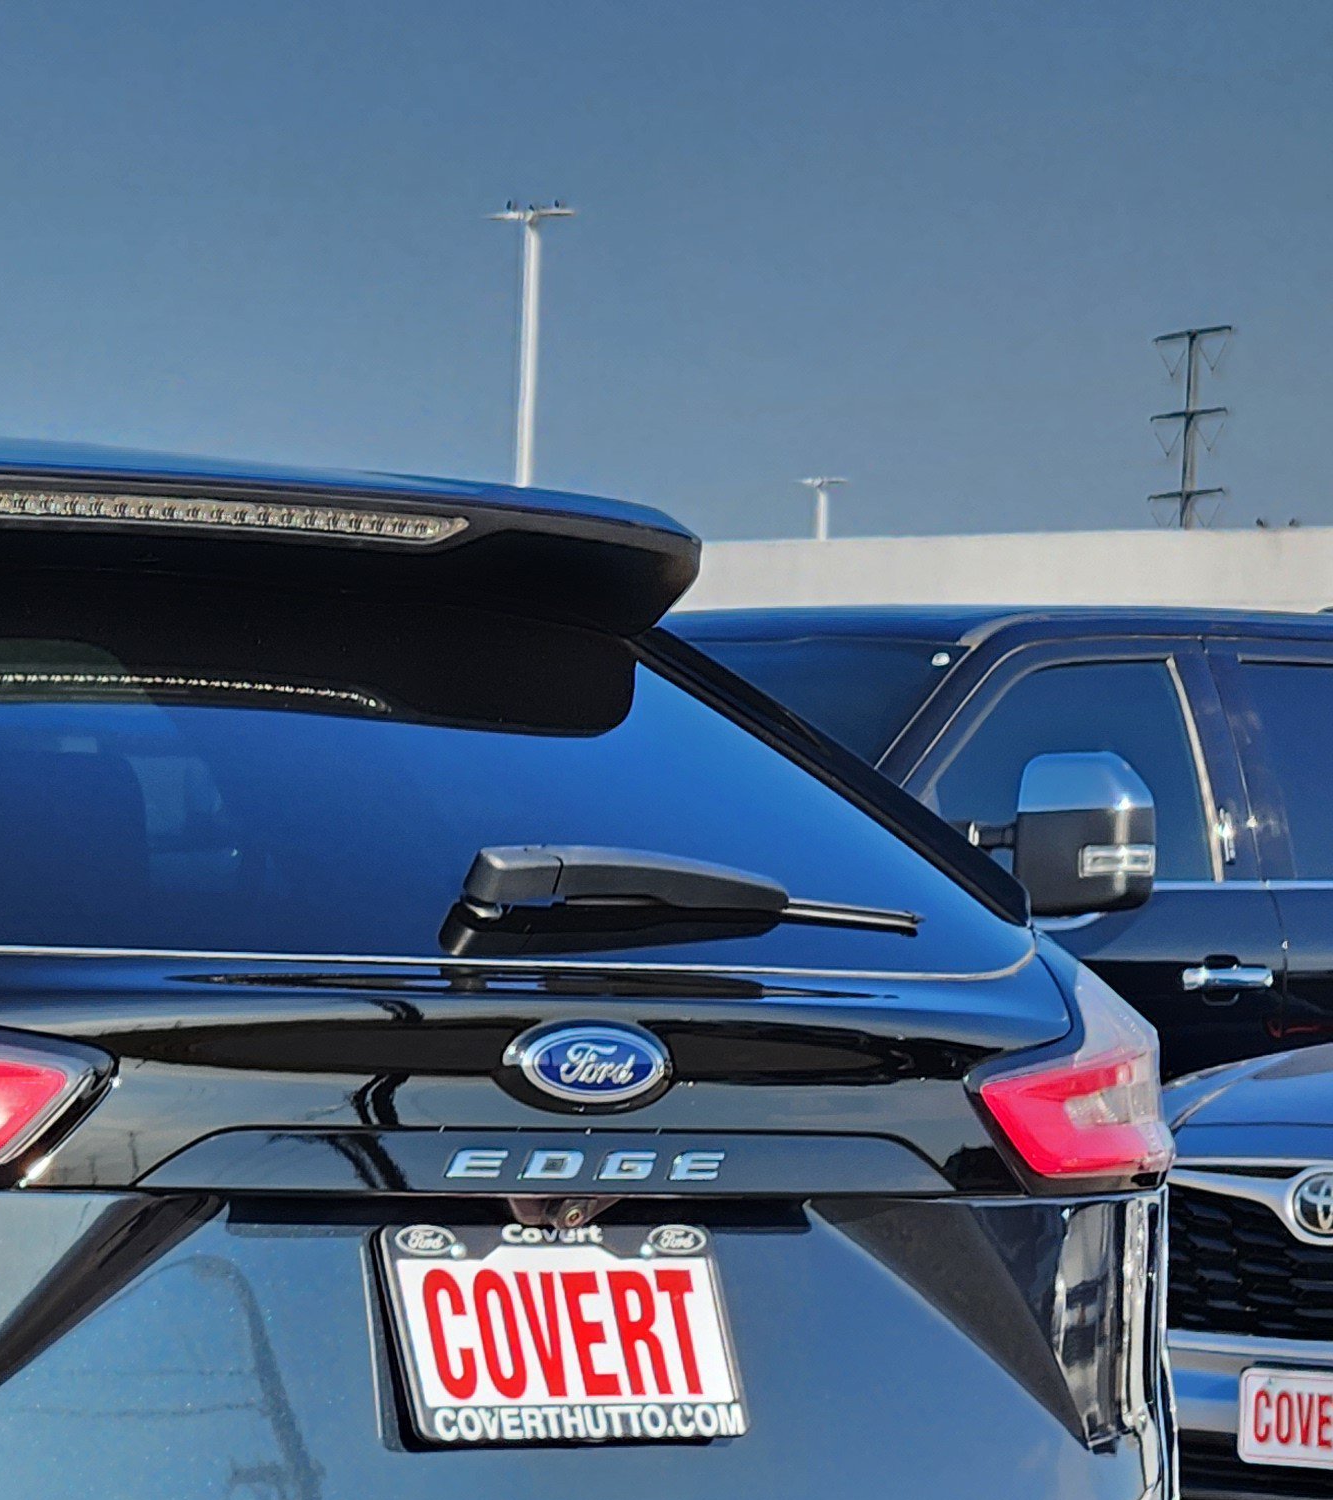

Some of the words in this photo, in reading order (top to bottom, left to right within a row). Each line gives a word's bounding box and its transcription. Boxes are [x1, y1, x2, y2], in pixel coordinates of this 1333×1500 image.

[559, 1042, 636, 1085] Ford
[444, 1149, 726, 1181] EDGE
[501, 1223, 604, 1244] Covert
[421, 1268, 704, 1400] COVERT
[433, 1402, 746, 1442] COVERTHUTTO.COM
[1253, 1389, 1333, 1448] COVE
